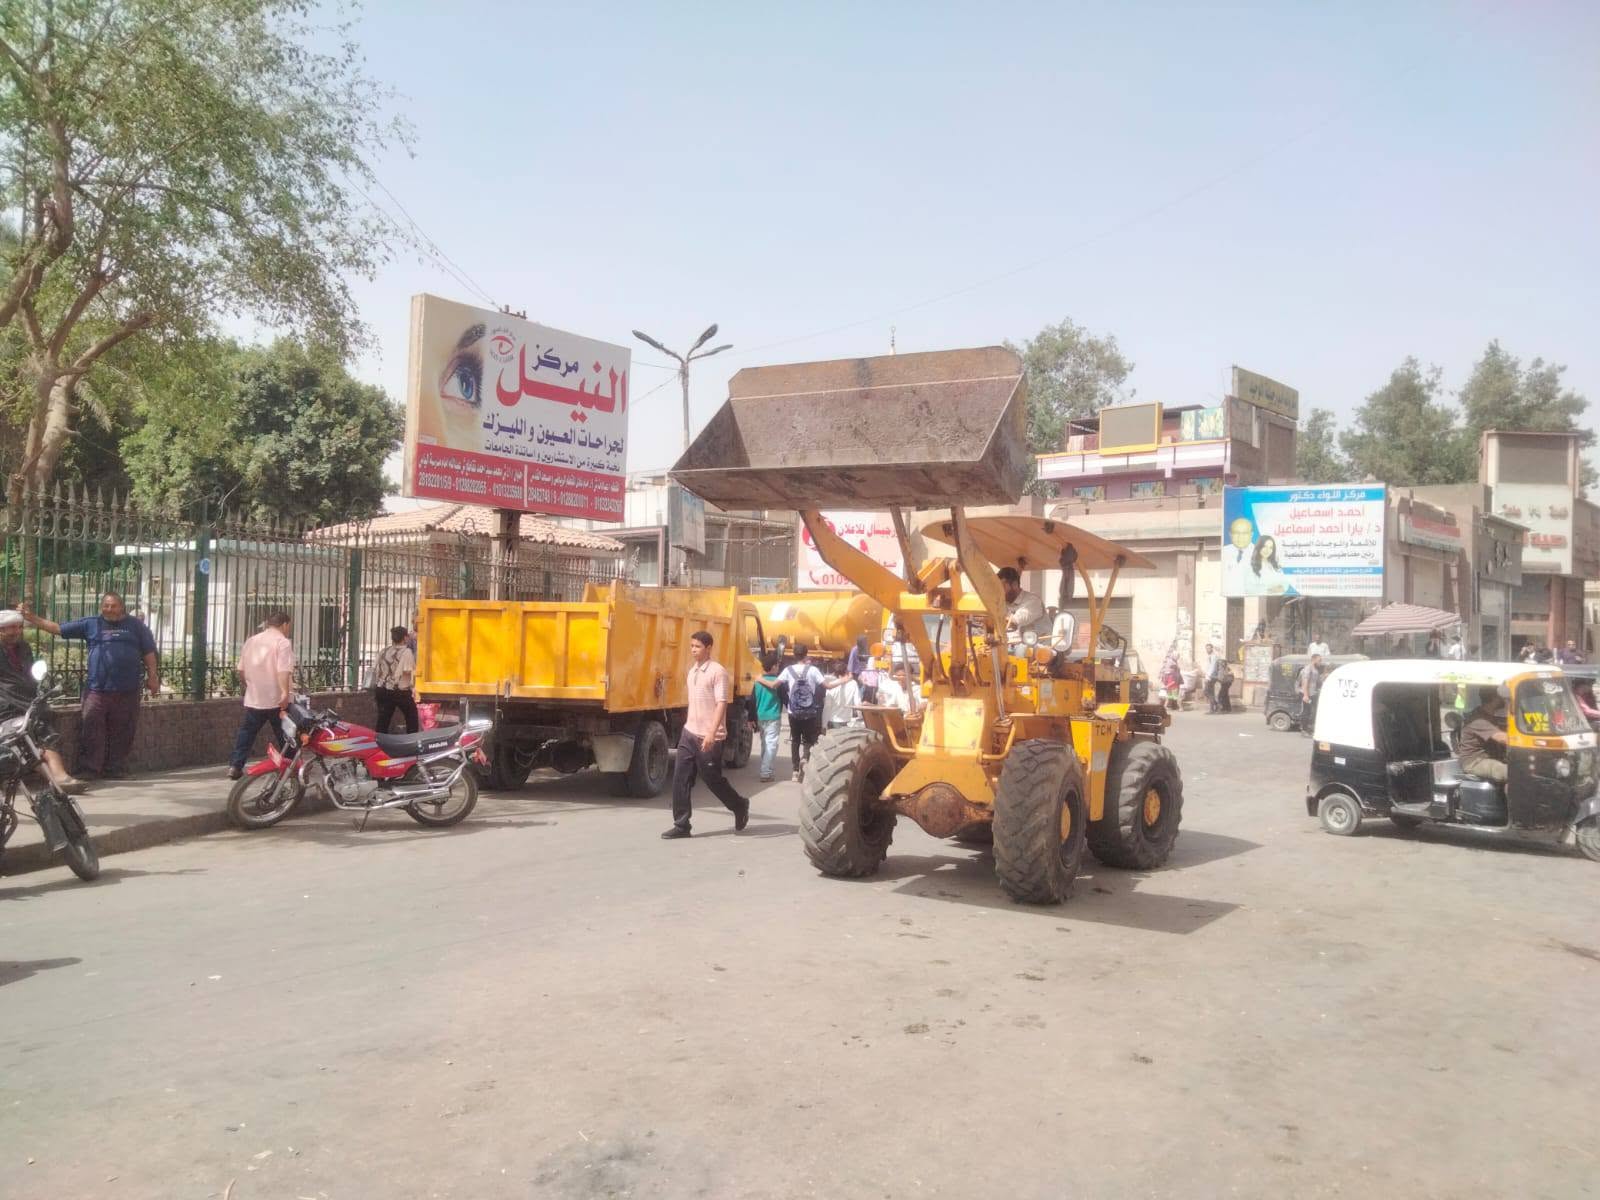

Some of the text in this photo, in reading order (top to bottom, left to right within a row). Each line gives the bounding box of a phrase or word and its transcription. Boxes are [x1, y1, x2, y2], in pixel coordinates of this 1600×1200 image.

[532, 343, 579, 377] مركز
[496, 342, 626, 424] النيل
[482, 412, 624, 458] لجراحات العيون و الليزك
[576, 459, 586, 469] من
[1289, 490, 1314, 502] دكتور
[1343, 489, 1366, 502] مركز
[1095, 724, 1112, 736] TCM
